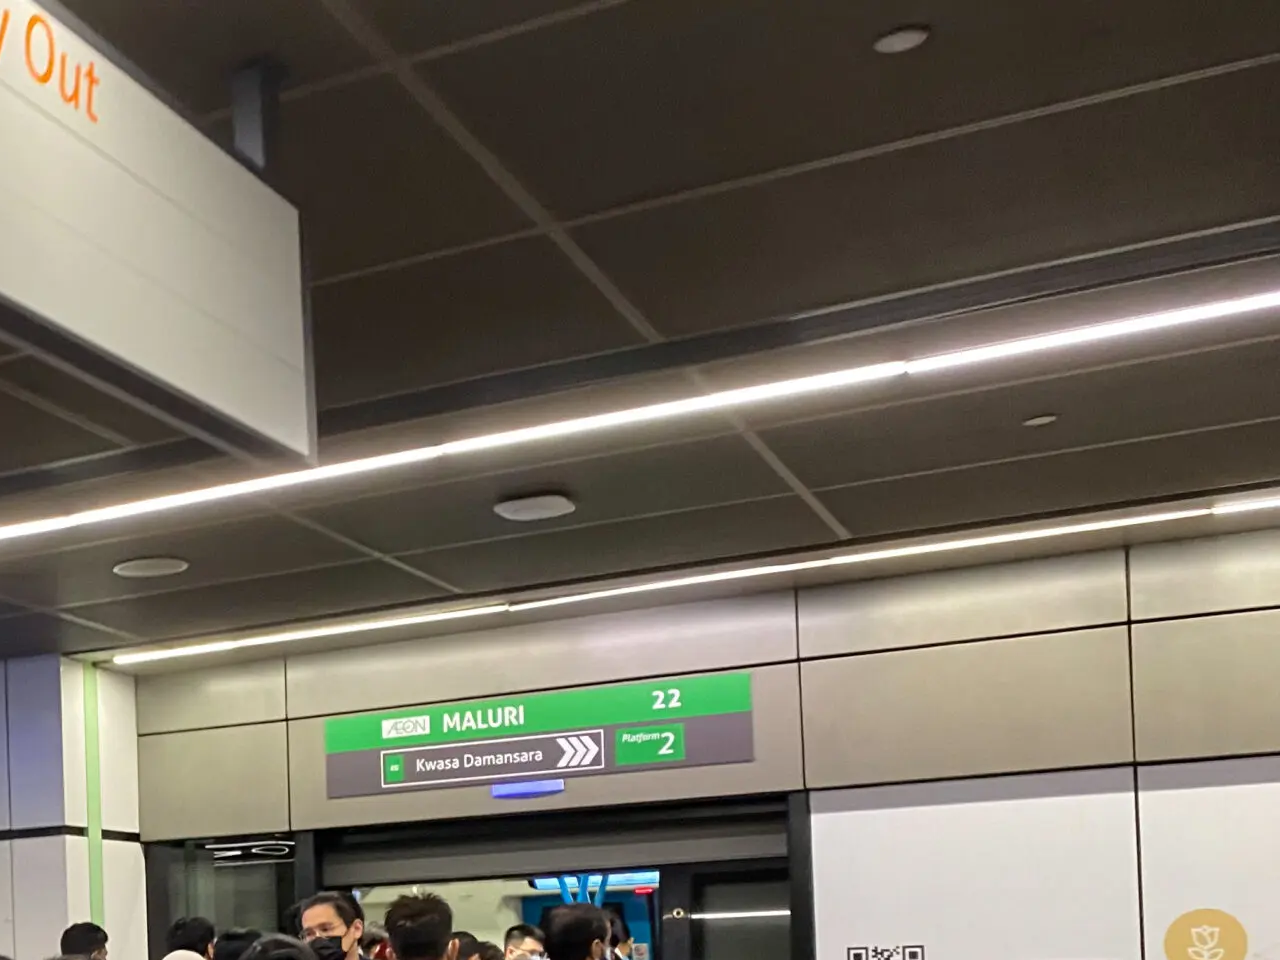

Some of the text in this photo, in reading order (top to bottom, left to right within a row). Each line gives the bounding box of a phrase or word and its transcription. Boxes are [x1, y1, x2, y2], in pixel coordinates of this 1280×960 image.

[24, 14, 100, 124] Out
[442, 688, 682, 733] MALURI 22
[622, 732, 675, 755] Platform 2
[416, 757, 460, 772] Kwasa
[463, 750, 543, 769] Damansara
